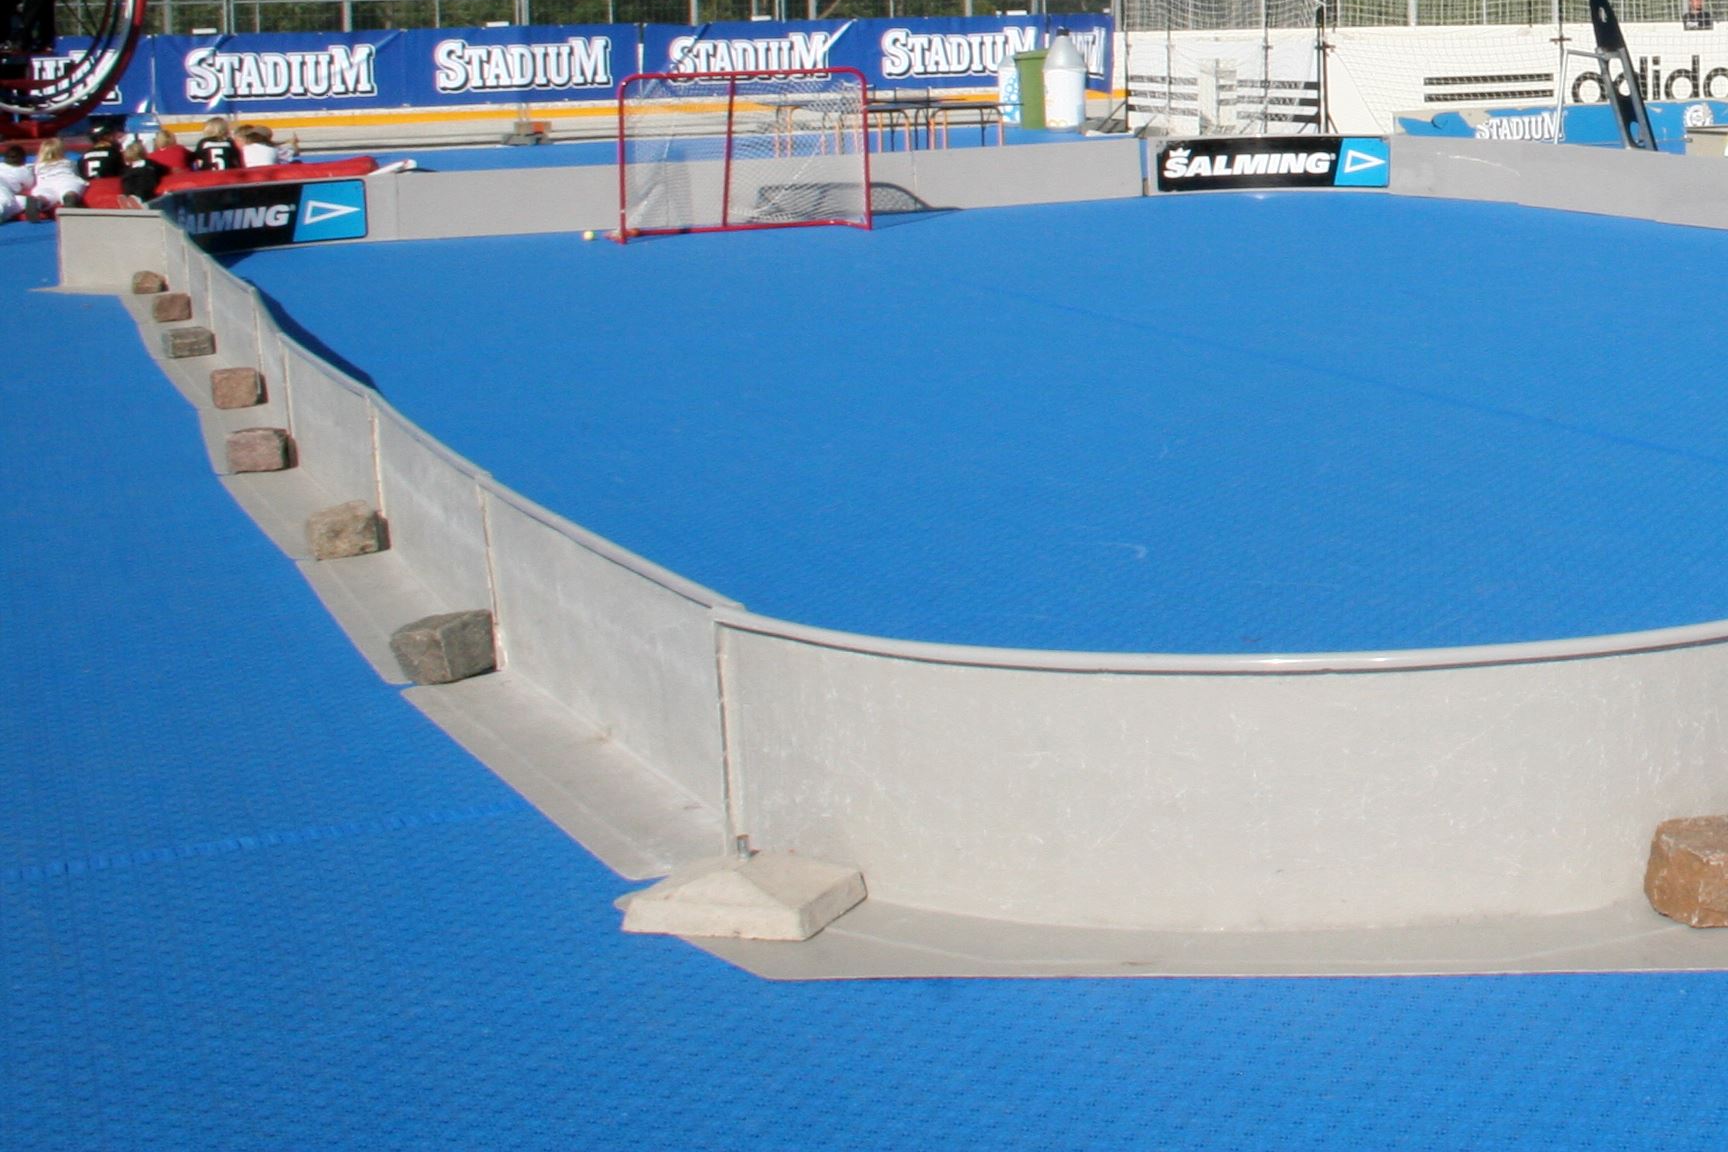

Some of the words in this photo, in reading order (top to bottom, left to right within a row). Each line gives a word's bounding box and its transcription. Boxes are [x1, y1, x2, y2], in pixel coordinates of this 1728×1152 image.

[184, 44, 377, 102] STADIUM
[434, 36, 613, 94] STADIUM
[668, 31, 832, 86] STADIUM
[211, 148, 226, 171] 5
[1163, 152, 1332, 178] SALMING
